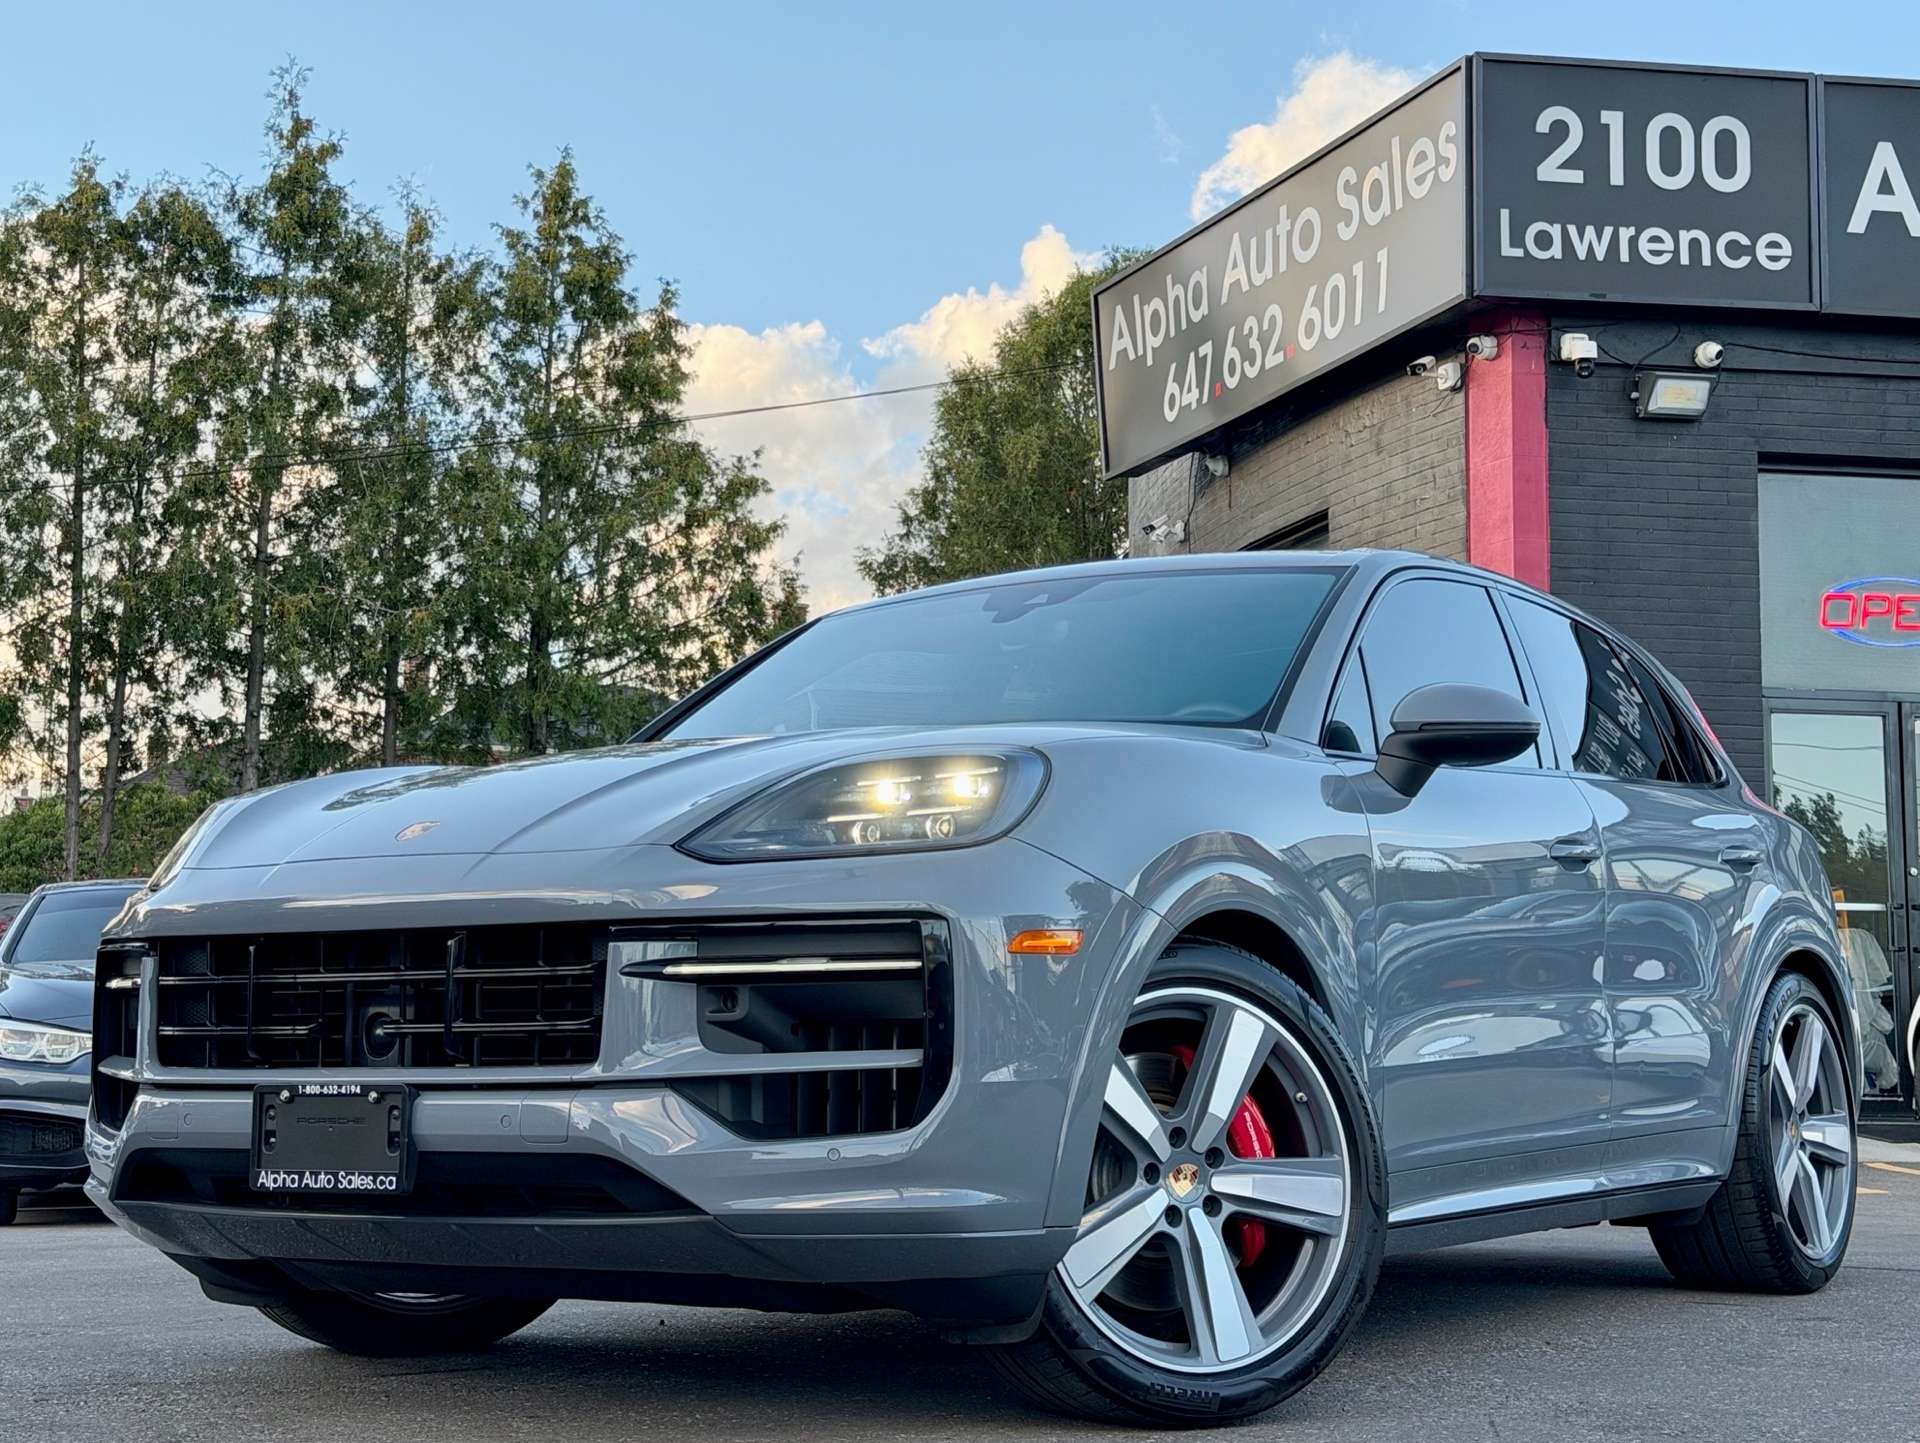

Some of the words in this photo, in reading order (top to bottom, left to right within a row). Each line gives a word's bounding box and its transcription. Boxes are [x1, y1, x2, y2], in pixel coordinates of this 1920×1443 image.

[1535, 105, 1751, 193] 2100
[1108, 265, 1209, 371] Alpha
[1221, 204, 1322, 307] Auto
[1336, 120, 1458, 241] Sales
[1500, 208, 1793, 271] Lawrence
[1163, 247, 1389, 423] 647.632.6011
[298, 1085, 361, 1095] 1-800-632-4194
[257, 1170, 299, 1191] Alpha
[301, 1171, 335, 1189] Auto
[337, 1171, 397, 1190] Sales.ca
